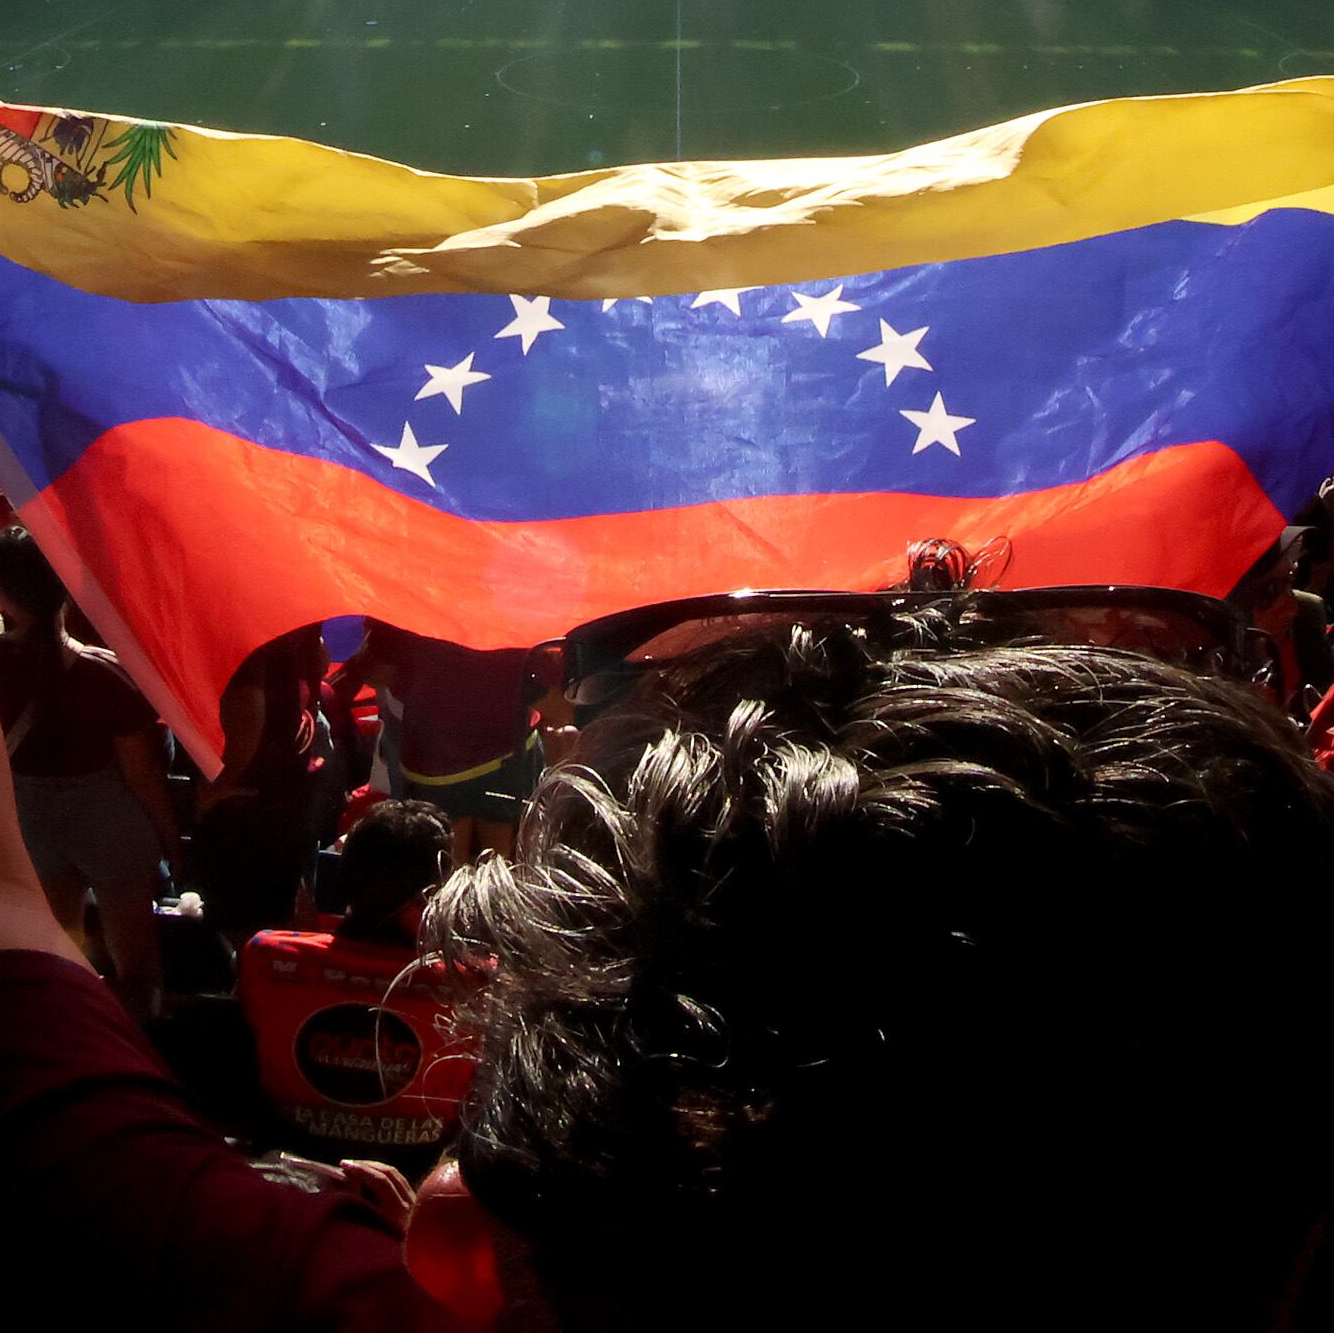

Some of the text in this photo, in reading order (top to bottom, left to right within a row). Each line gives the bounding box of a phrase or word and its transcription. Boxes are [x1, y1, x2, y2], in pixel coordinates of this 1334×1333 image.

[319, 1108, 373, 1127] CASA
[380, 1116, 406, 1130] DE
[308, 1122, 442, 1145] MANGUERAS
